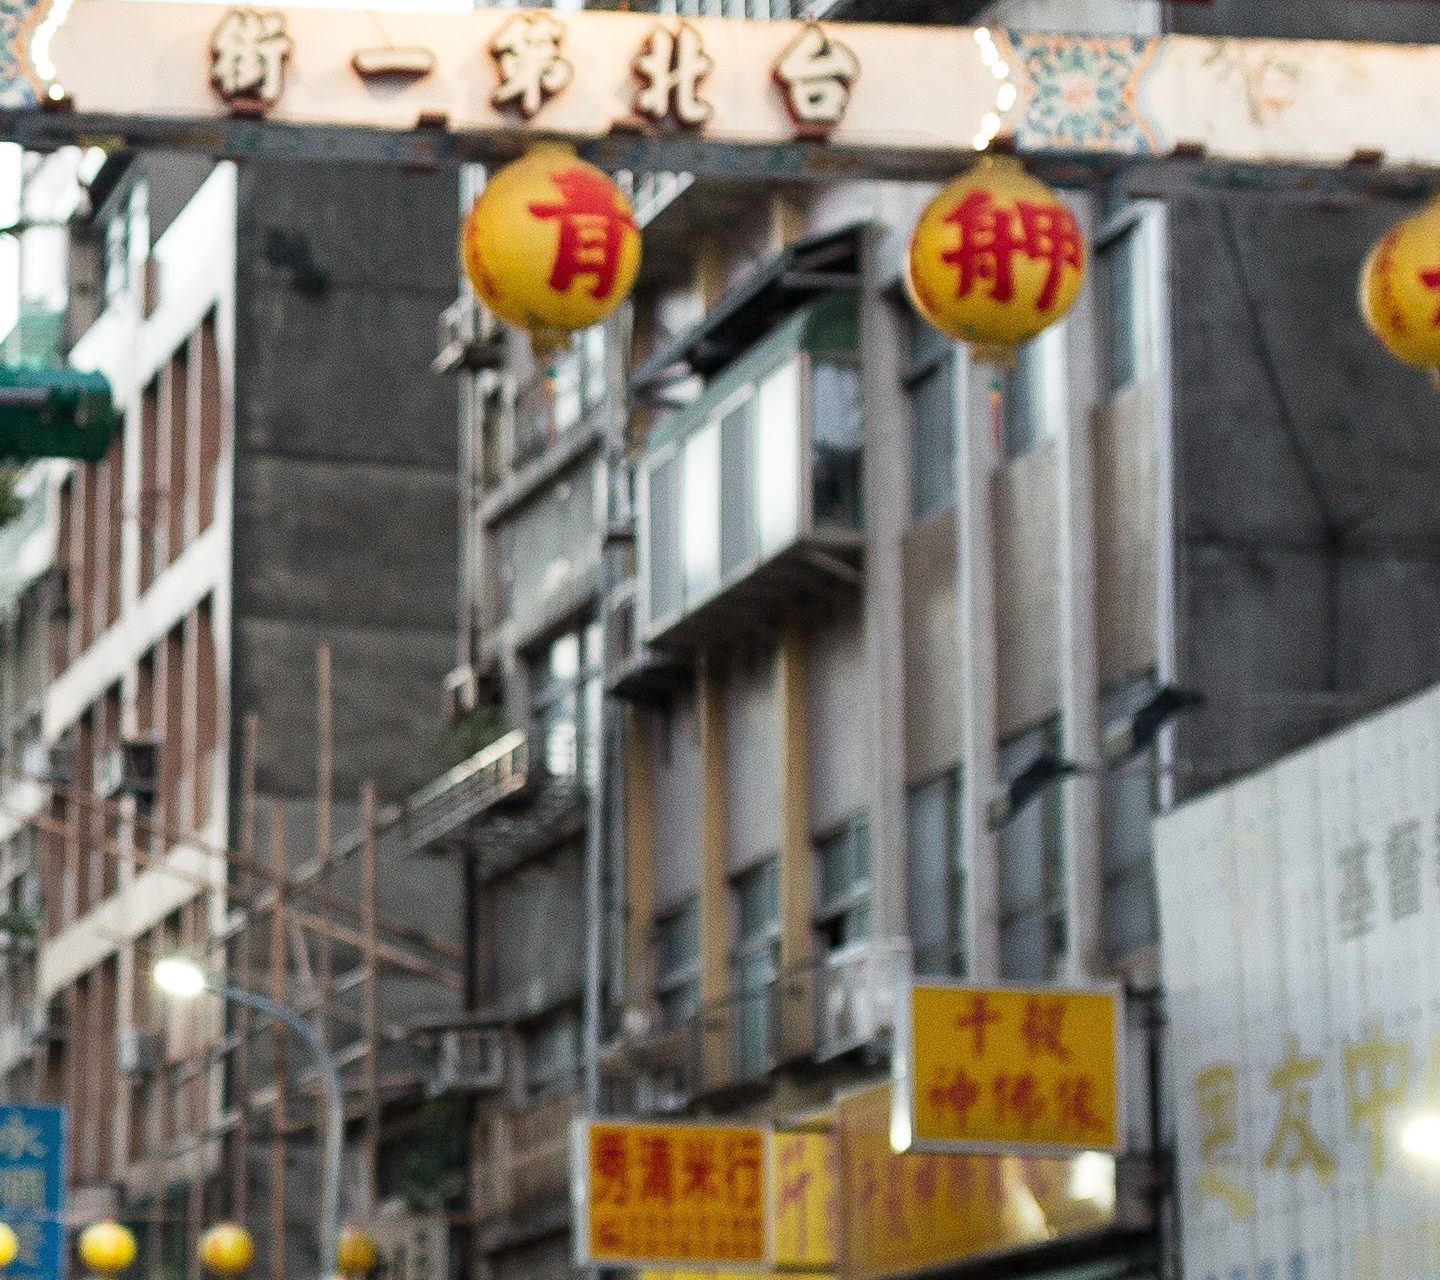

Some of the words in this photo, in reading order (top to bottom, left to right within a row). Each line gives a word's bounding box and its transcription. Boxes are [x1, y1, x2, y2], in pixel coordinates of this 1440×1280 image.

[207, 4, 864, 140] 台北第一街
[526, 168, 642, 300] 青
[940, 187, 1083, 314] 舺
